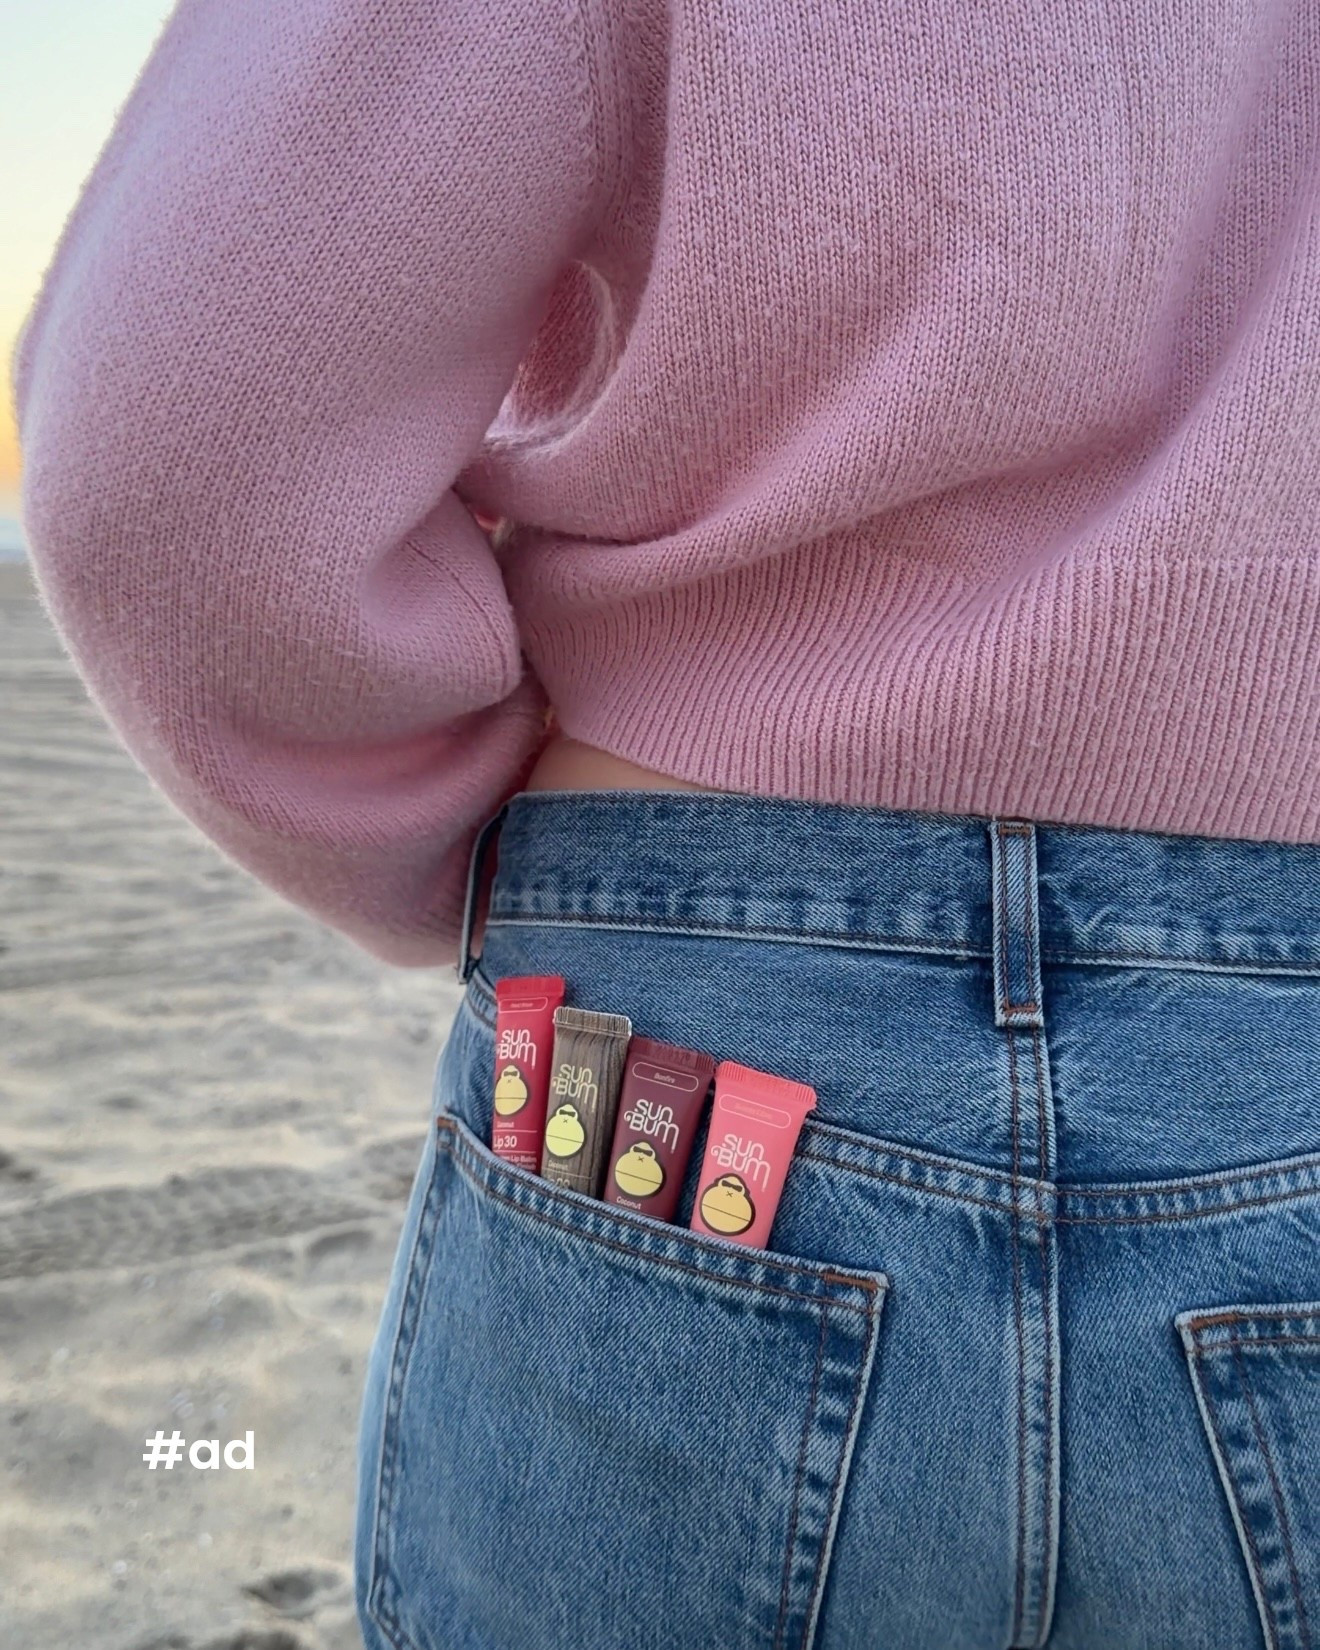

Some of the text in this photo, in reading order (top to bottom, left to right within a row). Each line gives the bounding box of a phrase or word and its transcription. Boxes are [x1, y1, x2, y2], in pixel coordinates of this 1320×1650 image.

[634, 1098, 673, 1123] SUN
[504, 1135, 517, 1148] 30
[624, 1109, 680, 1154] BUM
[721, 1133, 765, 1161] SUN
[710, 1144, 771, 1193] BUM
[616, 1195, 642, 1210] Coconut
